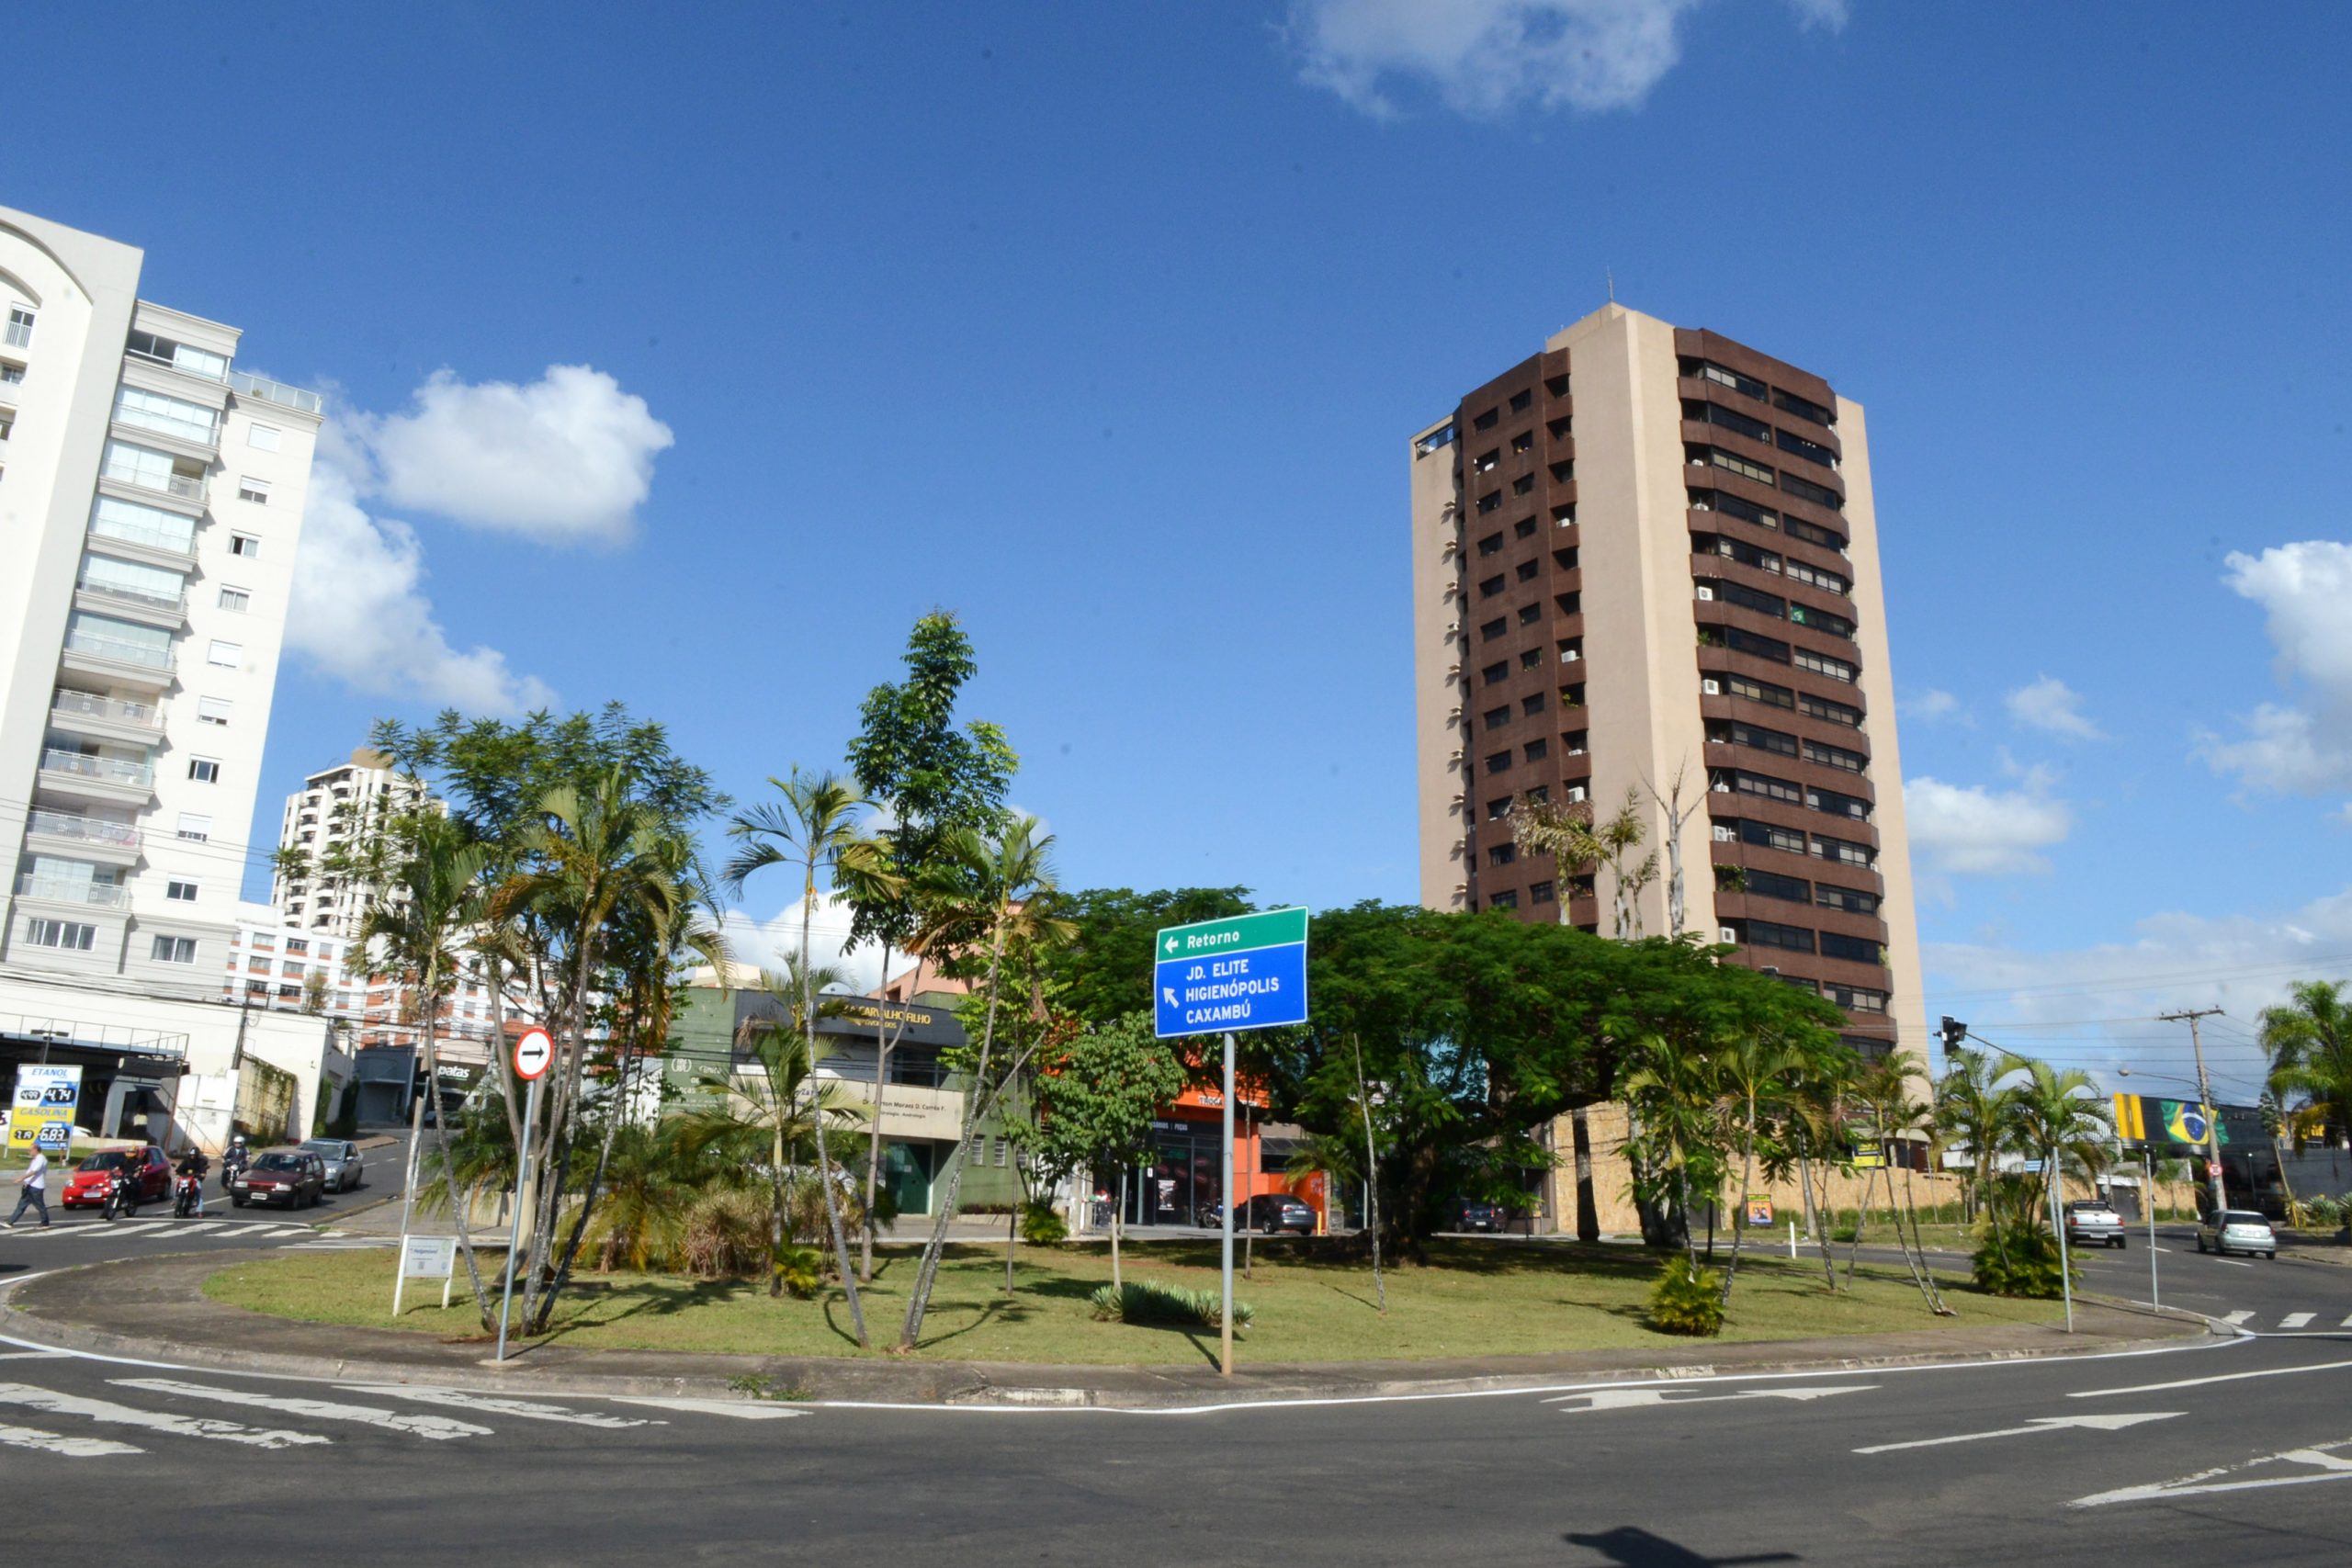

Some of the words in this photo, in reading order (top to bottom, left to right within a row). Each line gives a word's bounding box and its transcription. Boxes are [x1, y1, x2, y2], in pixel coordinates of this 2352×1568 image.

[1187, 931, 1239, 949] Retorno
[1186, 965, 1206, 981] JD.
[1213, 959, 1249, 977] ELITE
[1185, 977, 1279, 1002] HIGIENÓPOLIS
[906, 1012, 932, 1024] FILHO
[1186, 998, 1250, 1024] CAXAMBÚ
[32, 1068, 68, 1077] ETANOL
[20, 1107, 68, 1117] GASOLINA
